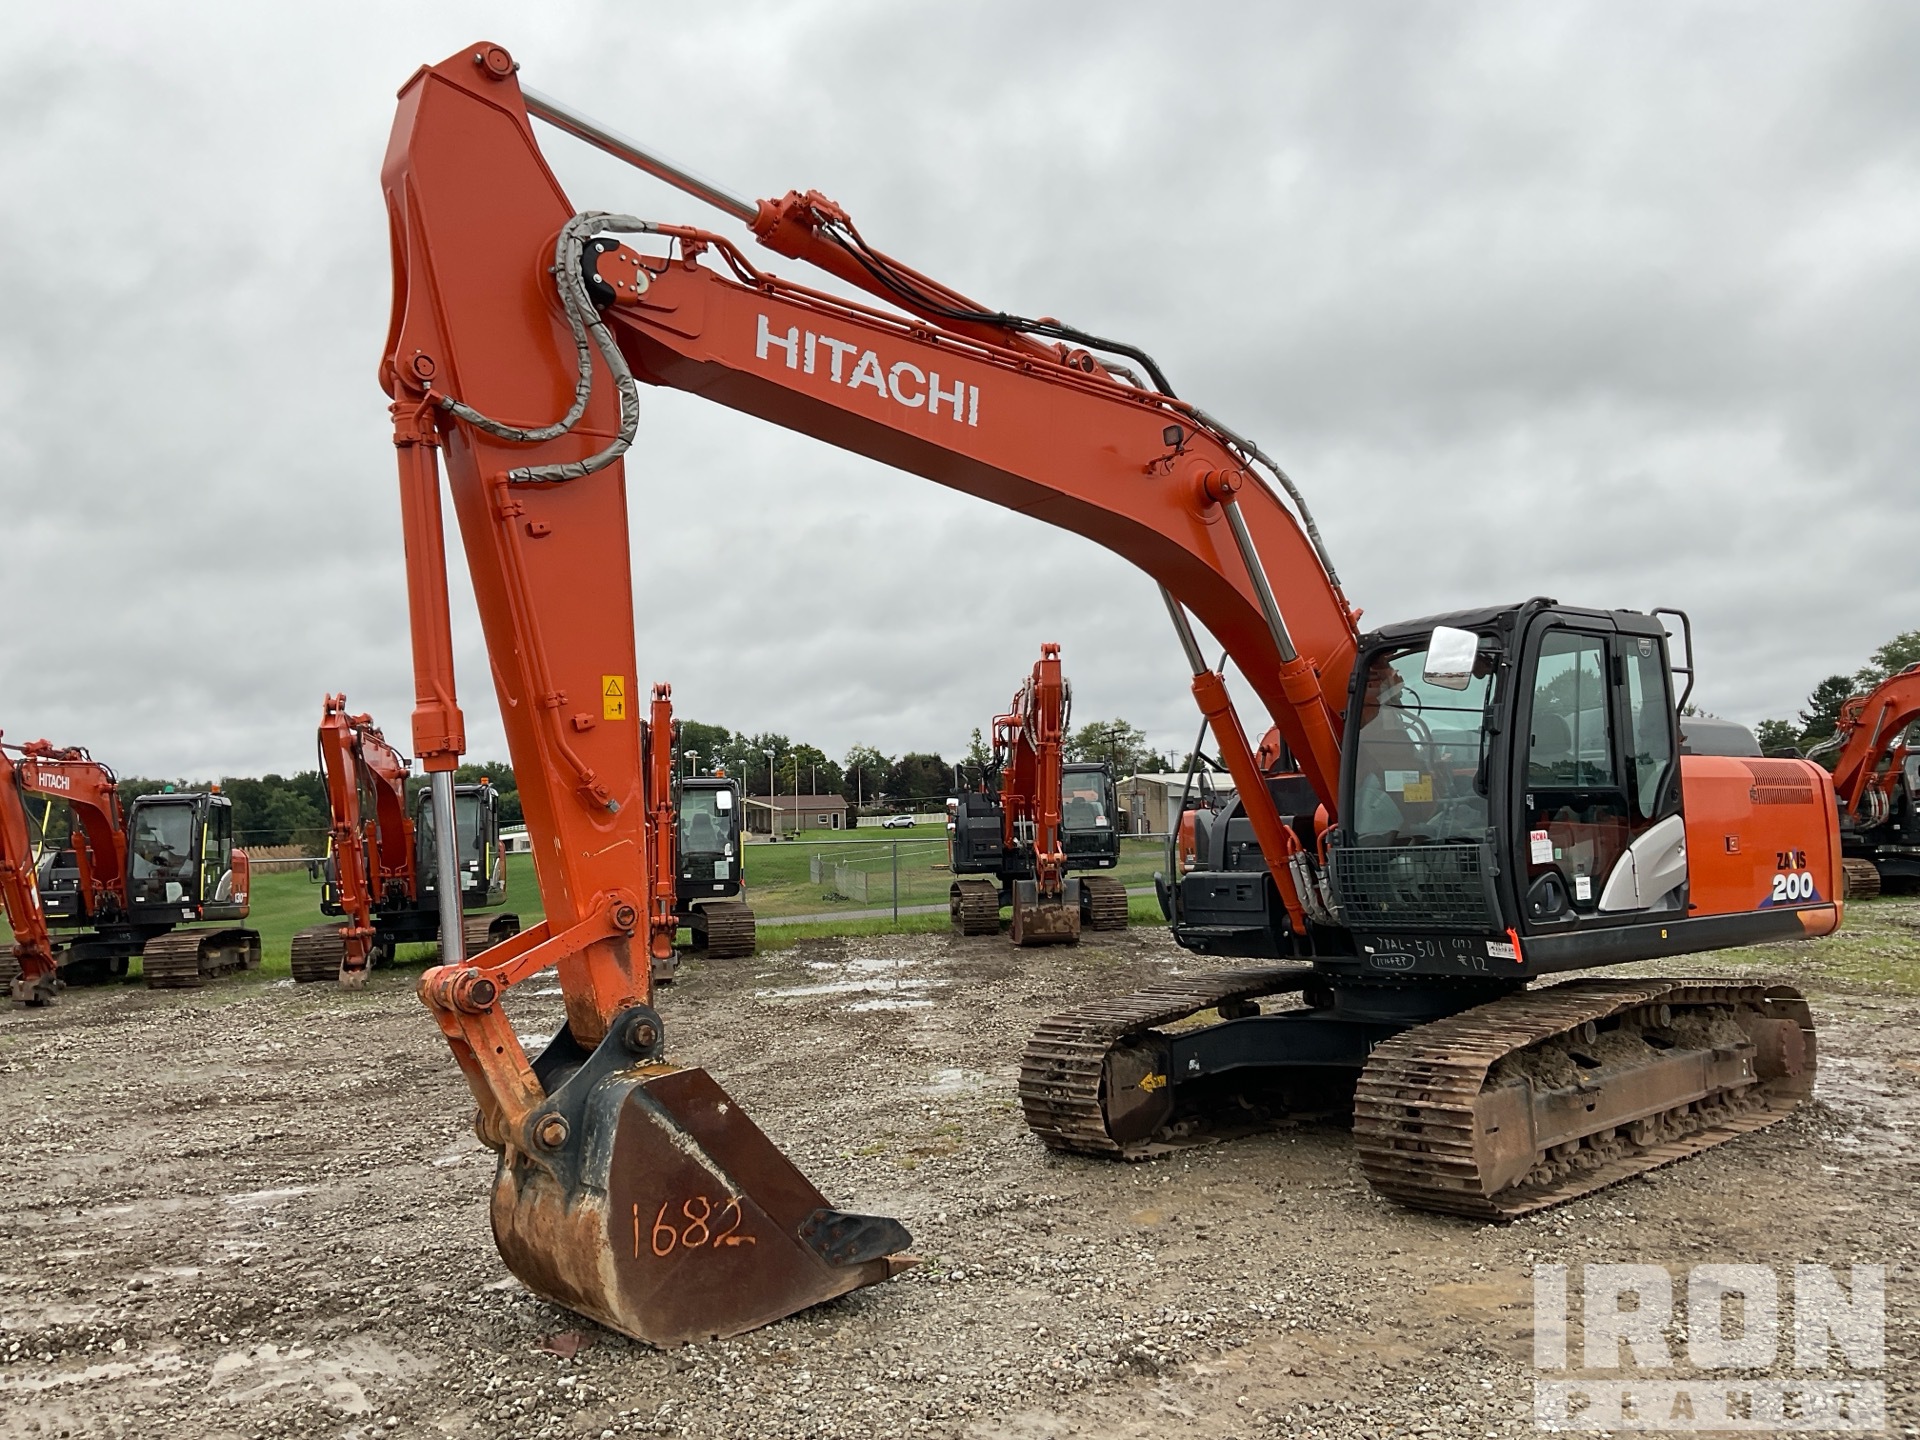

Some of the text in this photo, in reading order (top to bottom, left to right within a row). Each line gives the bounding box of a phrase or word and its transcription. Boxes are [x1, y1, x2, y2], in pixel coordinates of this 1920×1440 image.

[756, 314, 980, 427] HITACHI
[38, 772, 70, 790] HITACHI
[1777, 848, 1807, 870] ZAXIS
[1773, 872, 1814, 901] 200
[632, 1195, 756, 1258] 1682
